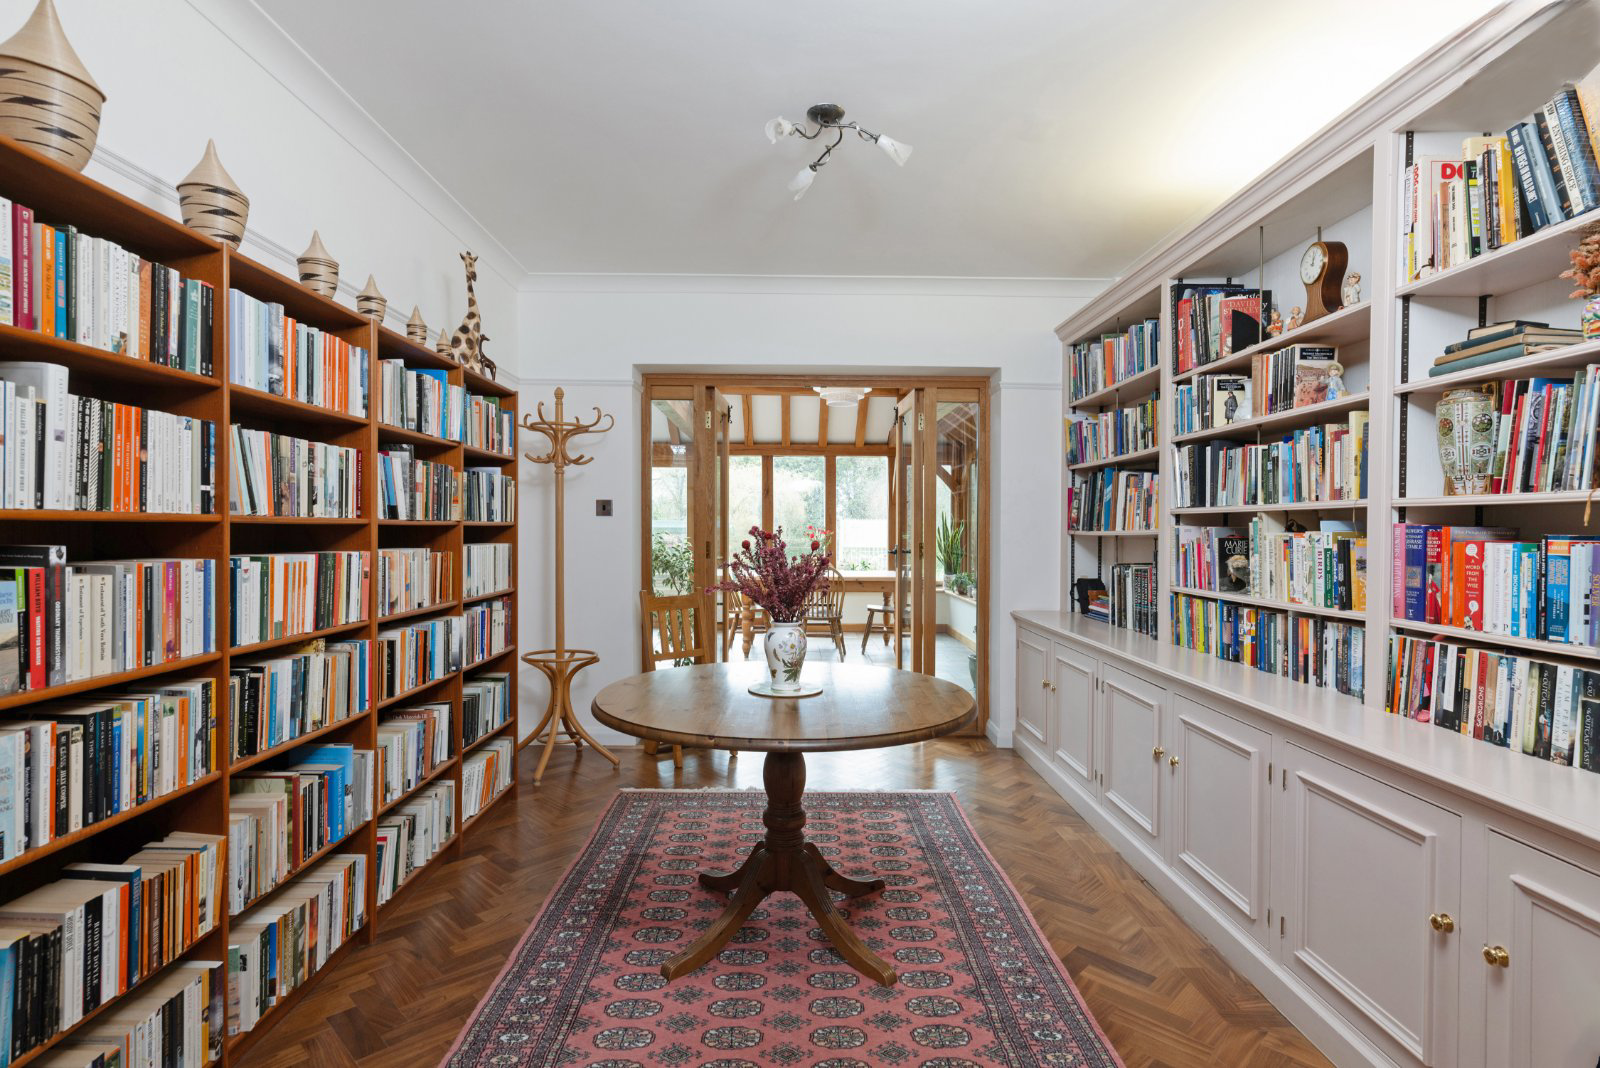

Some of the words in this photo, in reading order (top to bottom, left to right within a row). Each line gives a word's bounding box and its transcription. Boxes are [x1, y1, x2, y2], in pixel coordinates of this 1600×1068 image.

[1552, 124, 1567, 165] ENTERING
[1563, 166, 1576, 191] SPACE
[1226, 546, 1248, 554] CURIE
[1591, 574, 1599, 607] SOLVER
[1476, 685, 1484, 728] SNOWDROPS
[1540, 676, 1548, 709] OUTCAST
[1561, 708, 1569, 744] PEARS
[1583, 713, 1591, 746] OUTCAST
